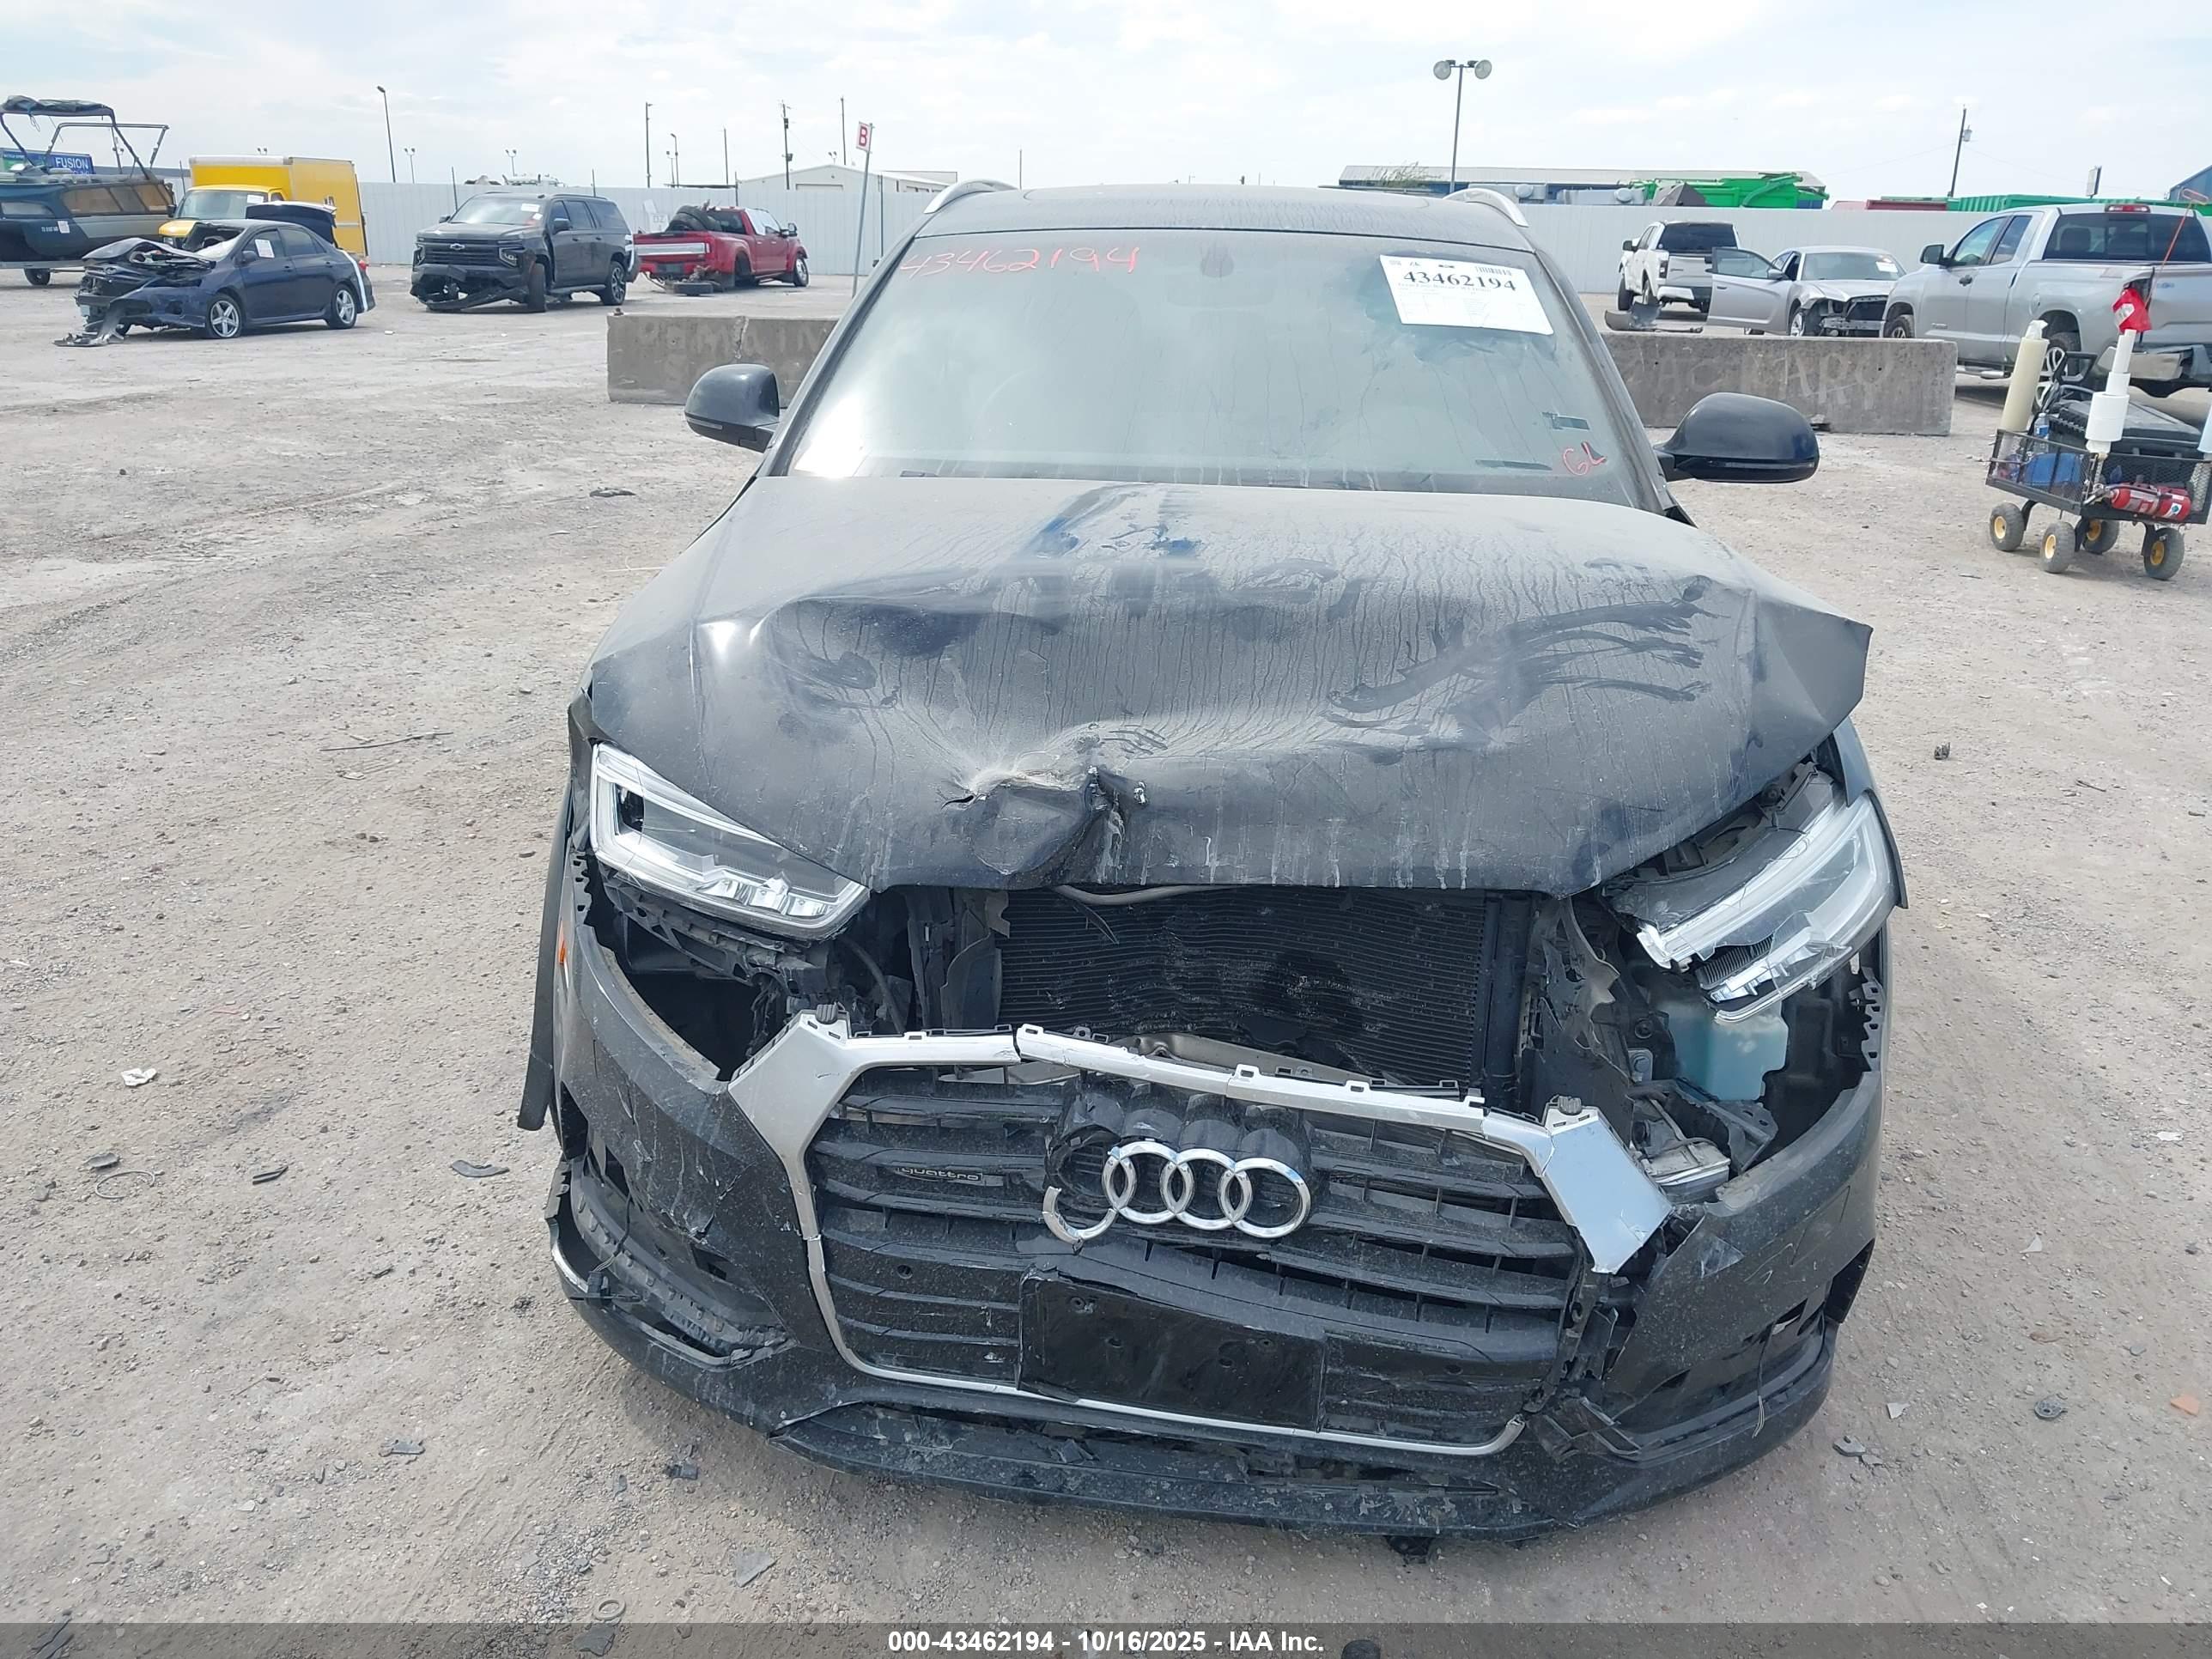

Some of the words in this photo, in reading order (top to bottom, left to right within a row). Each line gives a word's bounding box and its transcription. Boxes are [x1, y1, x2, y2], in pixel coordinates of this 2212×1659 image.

[859, 125, 867, 147] B
[55, 157, 89, 170] FUSION
[901, 247, 1139, 279] 43462194
[1403, 270, 1516, 291] 43462194
[902, 1167, 979, 1181] quattro
